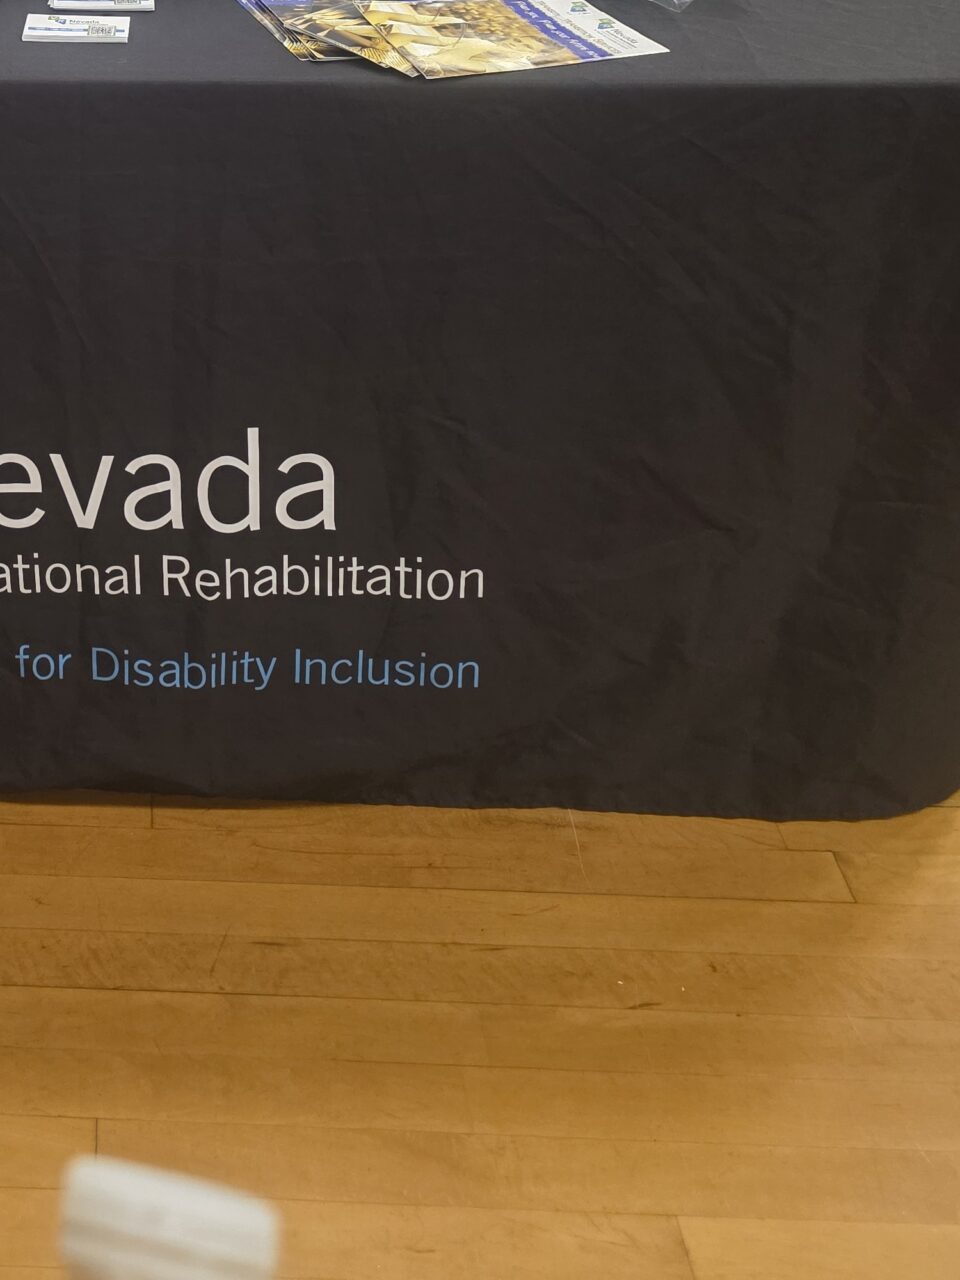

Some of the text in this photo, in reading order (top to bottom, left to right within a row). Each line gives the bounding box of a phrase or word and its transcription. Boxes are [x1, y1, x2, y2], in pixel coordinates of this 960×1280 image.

[161, 554, 485, 600] Rehabilitation
[15, 644, 73, 681] for
[91, 648, 278, 692] Disability
[292, 649, 480, 690] Inclusion
